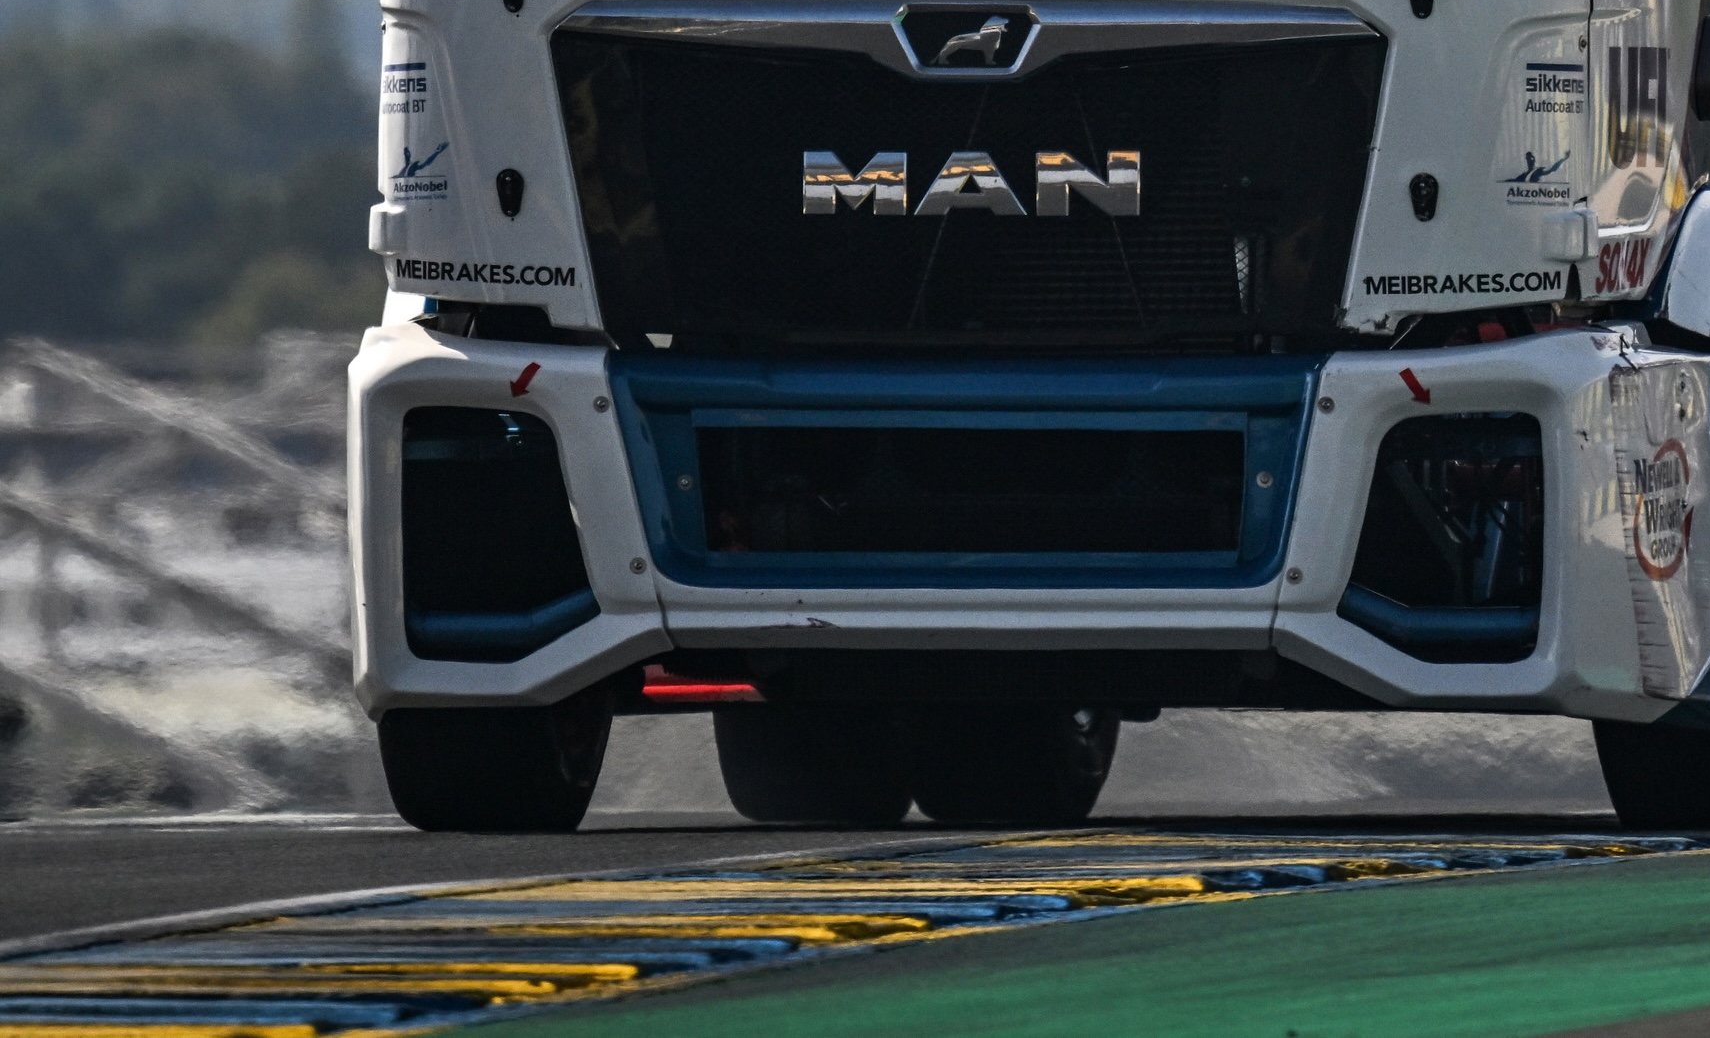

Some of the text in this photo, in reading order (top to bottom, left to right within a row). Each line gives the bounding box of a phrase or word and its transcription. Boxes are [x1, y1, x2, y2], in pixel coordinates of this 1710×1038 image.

[1526, 74, 1584, 94] sikkens
[412, 98, 426, 113] BT
[1525, 98, 1575, 114] Autocoat
[1608, 46, 1671, 170] UFI
[394, 180, 448, 193] AkzoNobel
[803, 150, 1141, 216] MAN
[1506, 186, 1571, 199] AkzoNobel
[396, 259, 576, 287] MEIBRAKES.COM
[1364, 271, 1562, 296] MEIBRAKES.COM
